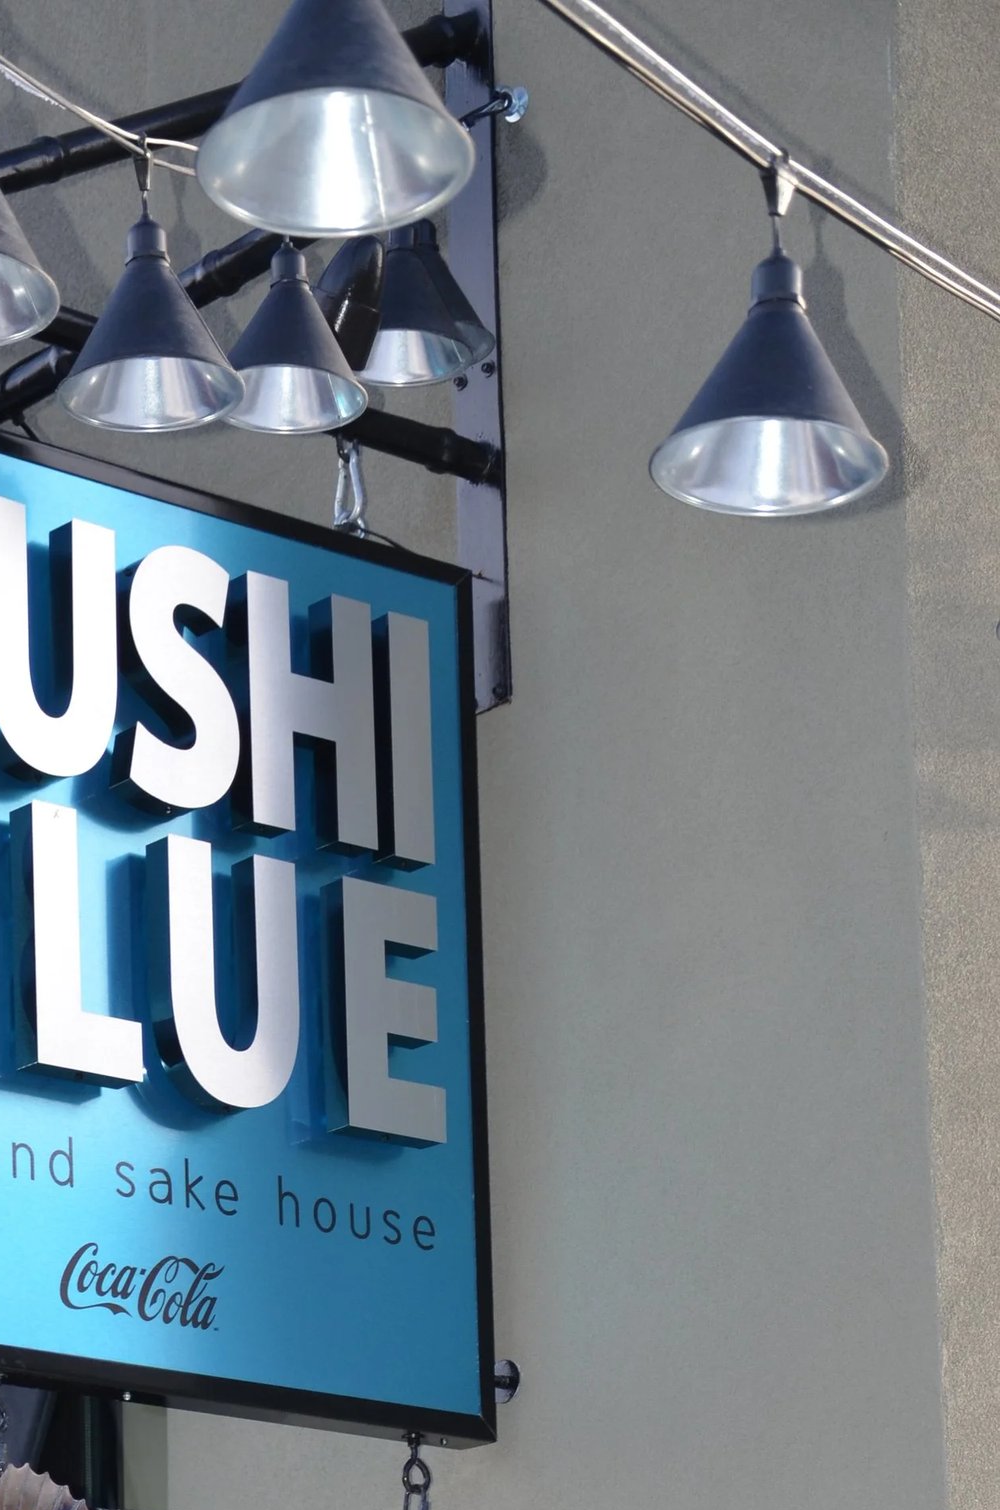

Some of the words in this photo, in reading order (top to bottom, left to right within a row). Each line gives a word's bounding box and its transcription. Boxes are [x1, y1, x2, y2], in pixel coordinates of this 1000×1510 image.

[115, 1157, 239, 1216] sake
[277, 1174, 436, 1251] house
[59, 1242, 226, 1331] Coca-Cola
